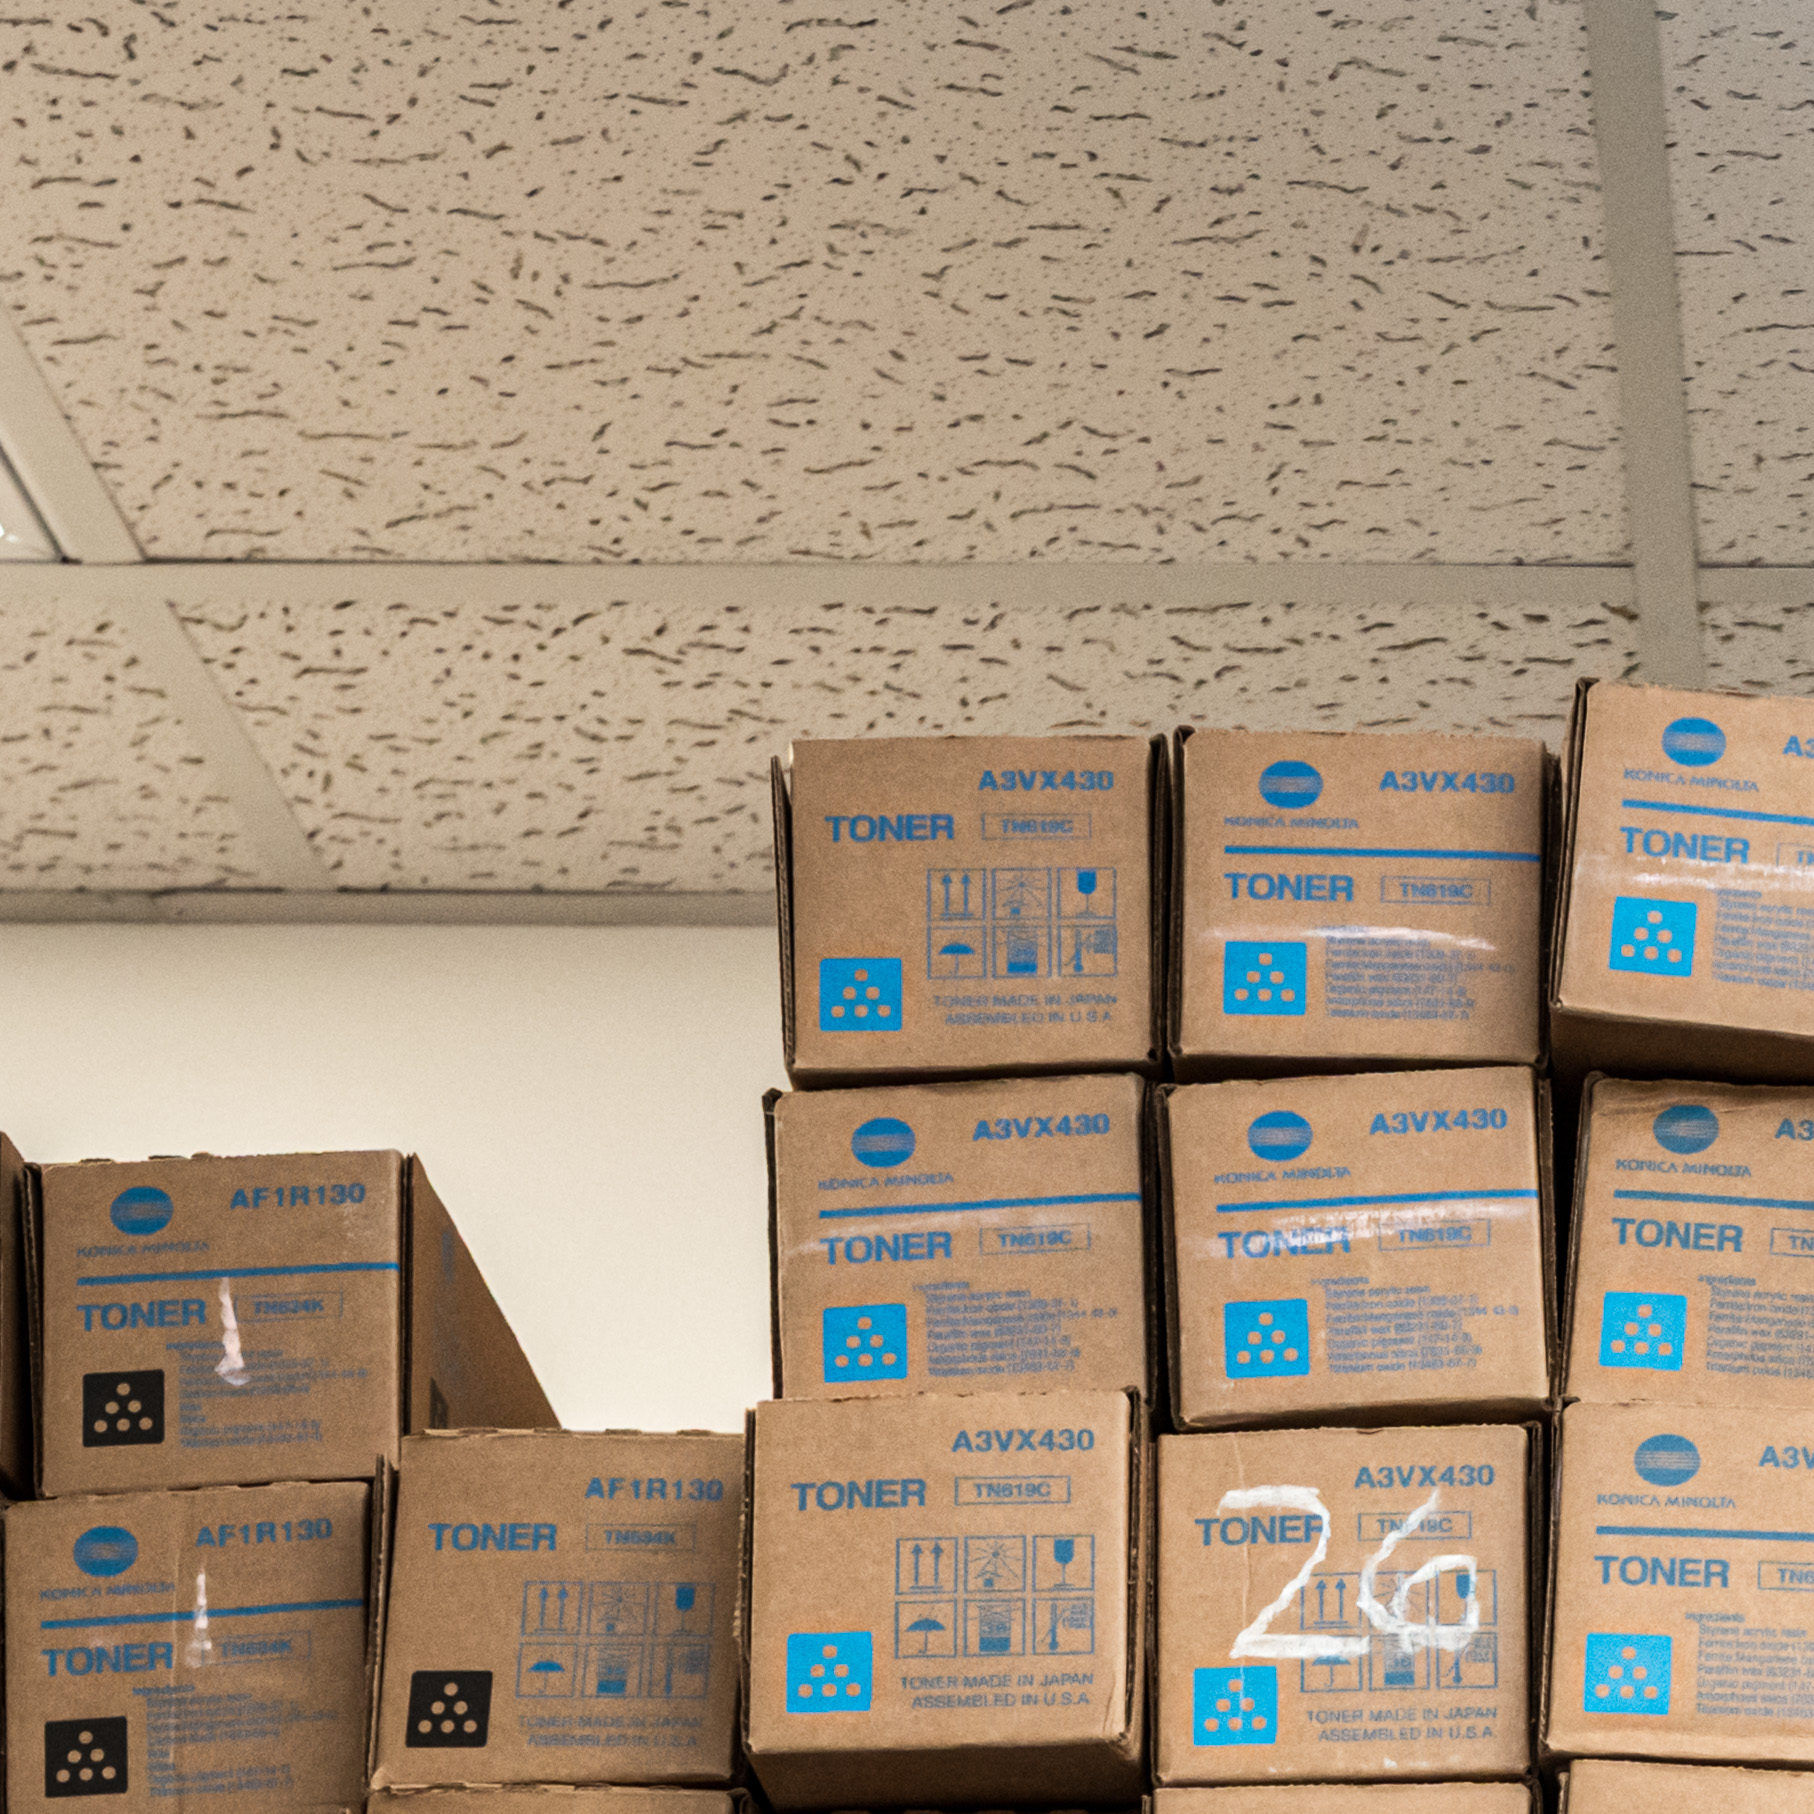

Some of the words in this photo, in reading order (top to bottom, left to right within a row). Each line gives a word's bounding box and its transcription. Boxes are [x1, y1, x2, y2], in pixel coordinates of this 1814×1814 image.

[1381, 772, 1516, 795] A3VX430
[1225, 873, 1355, 902] TONER
[974, 1114, 1111, 1142] A3VX430
[821, 1232, 953, 1265] TONER
[953, 1430, 1095, 1453] A3VX430
[1354, 1464, 1496, 1489] A3VX430
[791, 1479, 927, 1512] TONER
[974, 1480, 1053, 1501] TN619C
[1217, 1484, 1480, 1659] 26
[1595, 1556, 1731, 1588] TONER
